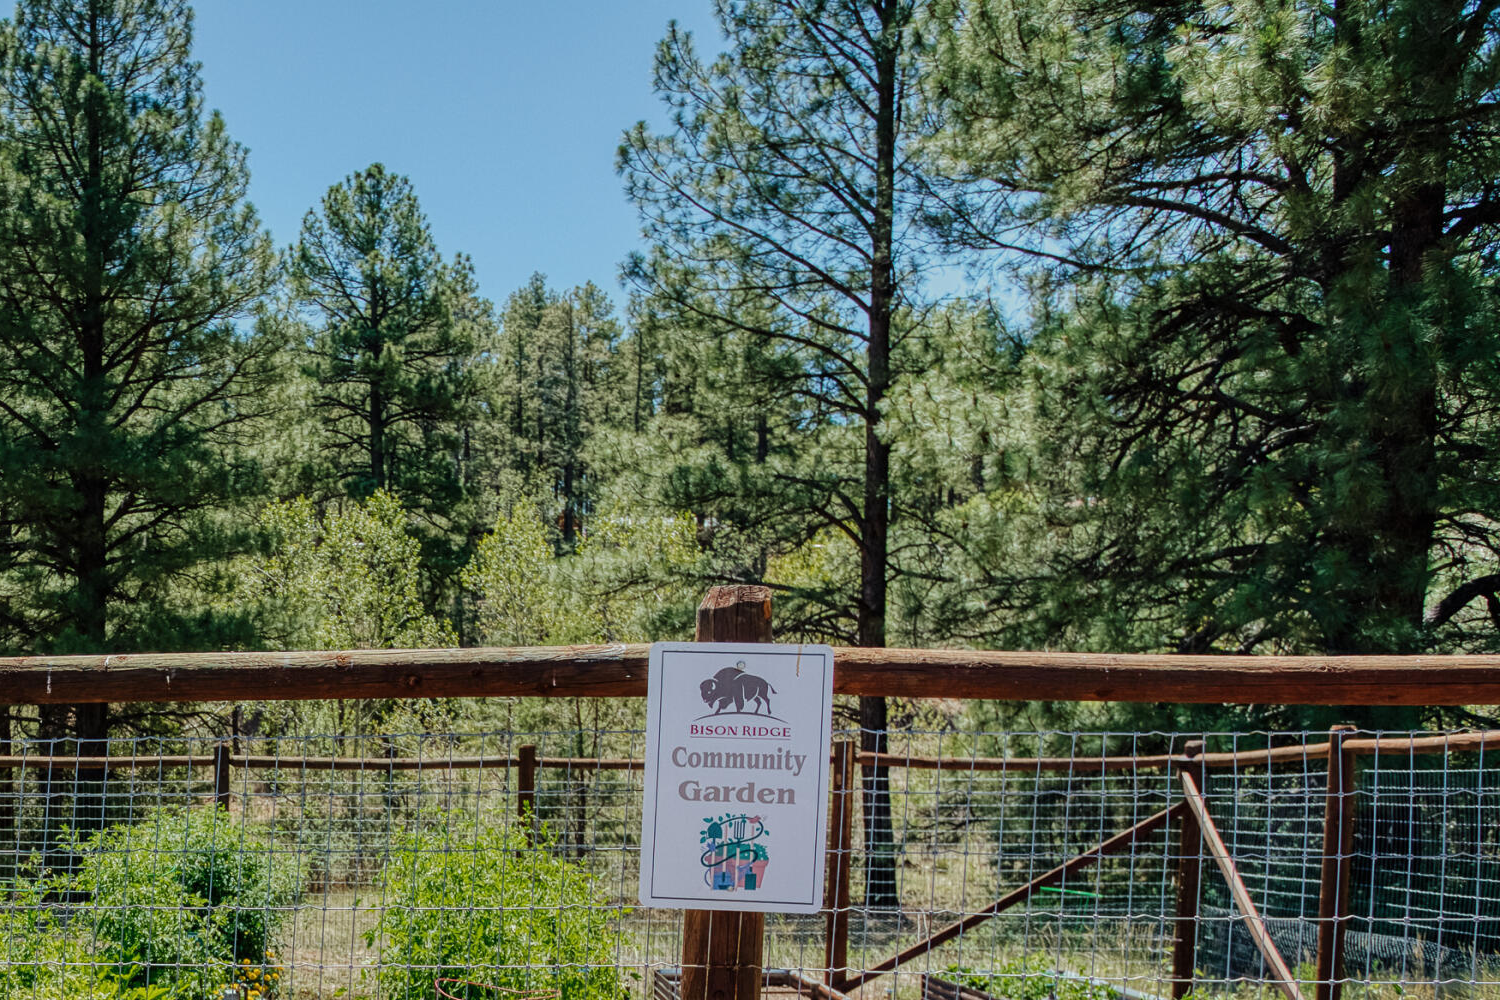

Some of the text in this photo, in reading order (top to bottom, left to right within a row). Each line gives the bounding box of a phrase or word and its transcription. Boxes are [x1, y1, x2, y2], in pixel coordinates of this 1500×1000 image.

[690, 724, 792, 738] BISON RIDGE
[671, 746, 806, 776] Community
[678, 780, 796, 805] Garden
